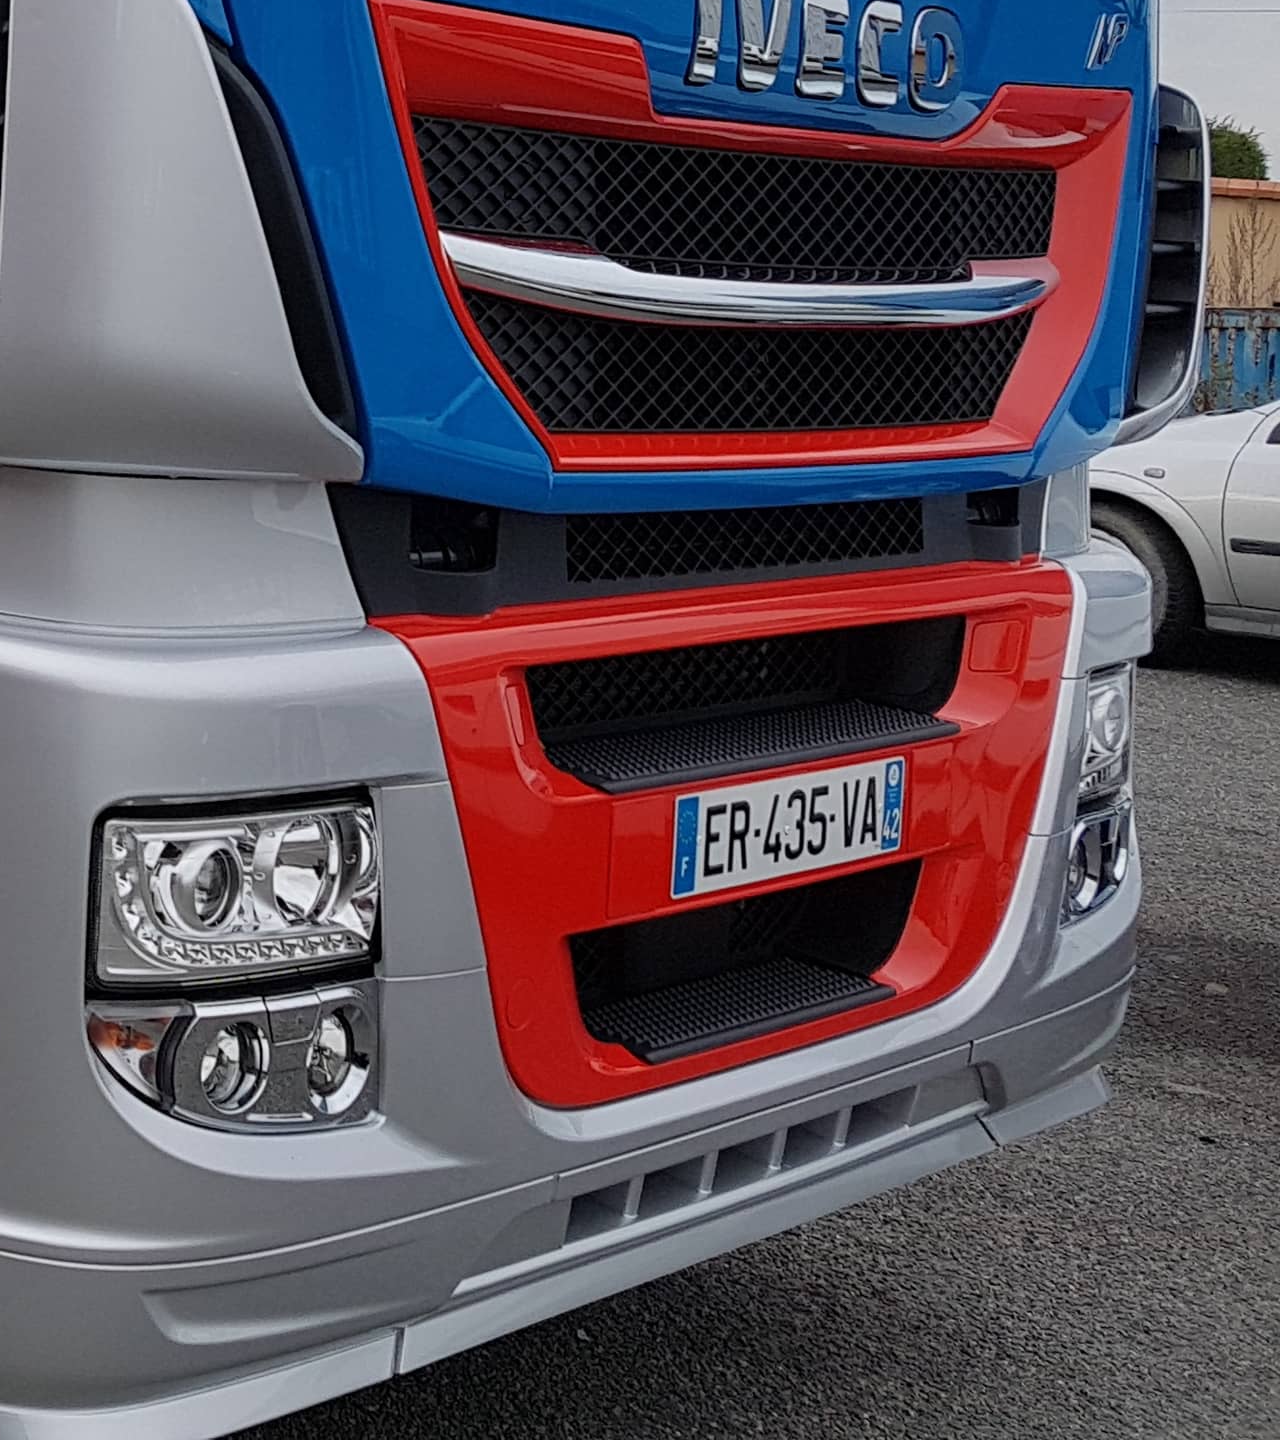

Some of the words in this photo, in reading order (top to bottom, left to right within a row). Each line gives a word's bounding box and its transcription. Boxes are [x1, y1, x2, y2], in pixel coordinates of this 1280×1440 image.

[703, 775, 878, 878] ER-435-VA
[882, 807, 900, 841] 42
[680, 856, 690, 878] F
